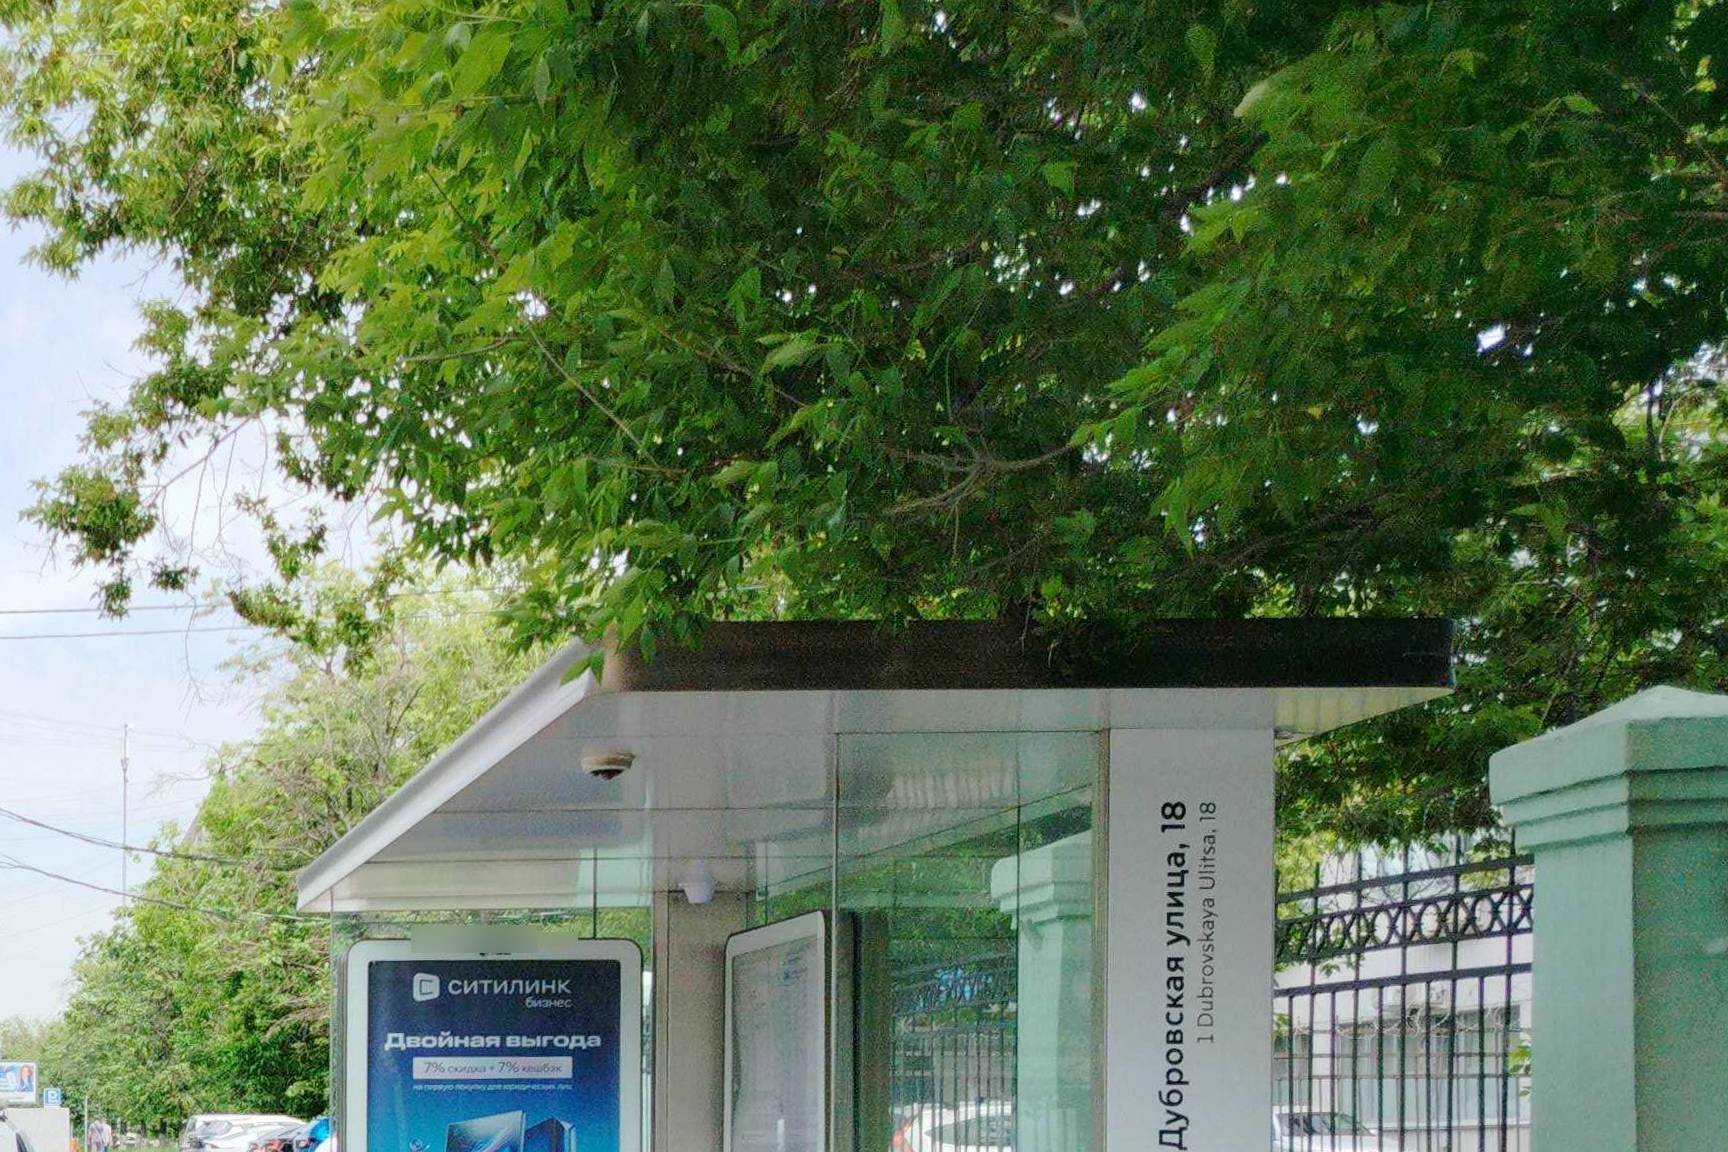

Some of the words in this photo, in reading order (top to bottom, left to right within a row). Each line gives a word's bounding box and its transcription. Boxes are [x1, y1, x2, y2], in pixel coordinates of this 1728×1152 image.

[1160, 801, 1187, 834] 18
[1198, 802, 1217, 822] 18
[1198, 828, 1218, 890] Ulitsa,
[1166, 843, 1191, 947] улица,
[1196, 897, 1220, 1028] Dubrovskaya
[447, 979, 571, 995] СИТИЛИНК
[525, 996, 572, 1008] бизнес
[384, 1031, 500, 1050] Двойная
[505, 1035, 602, 1050] выгода
[1196, 1033, 1215, 1044] 1
[1158, 956, 1191, 1151] Дубровская
[424, 1062, 446, 1074] 7%
[447, 1065, 486, 1075] скидка
[498, 1061, 520, 1073] 7%
